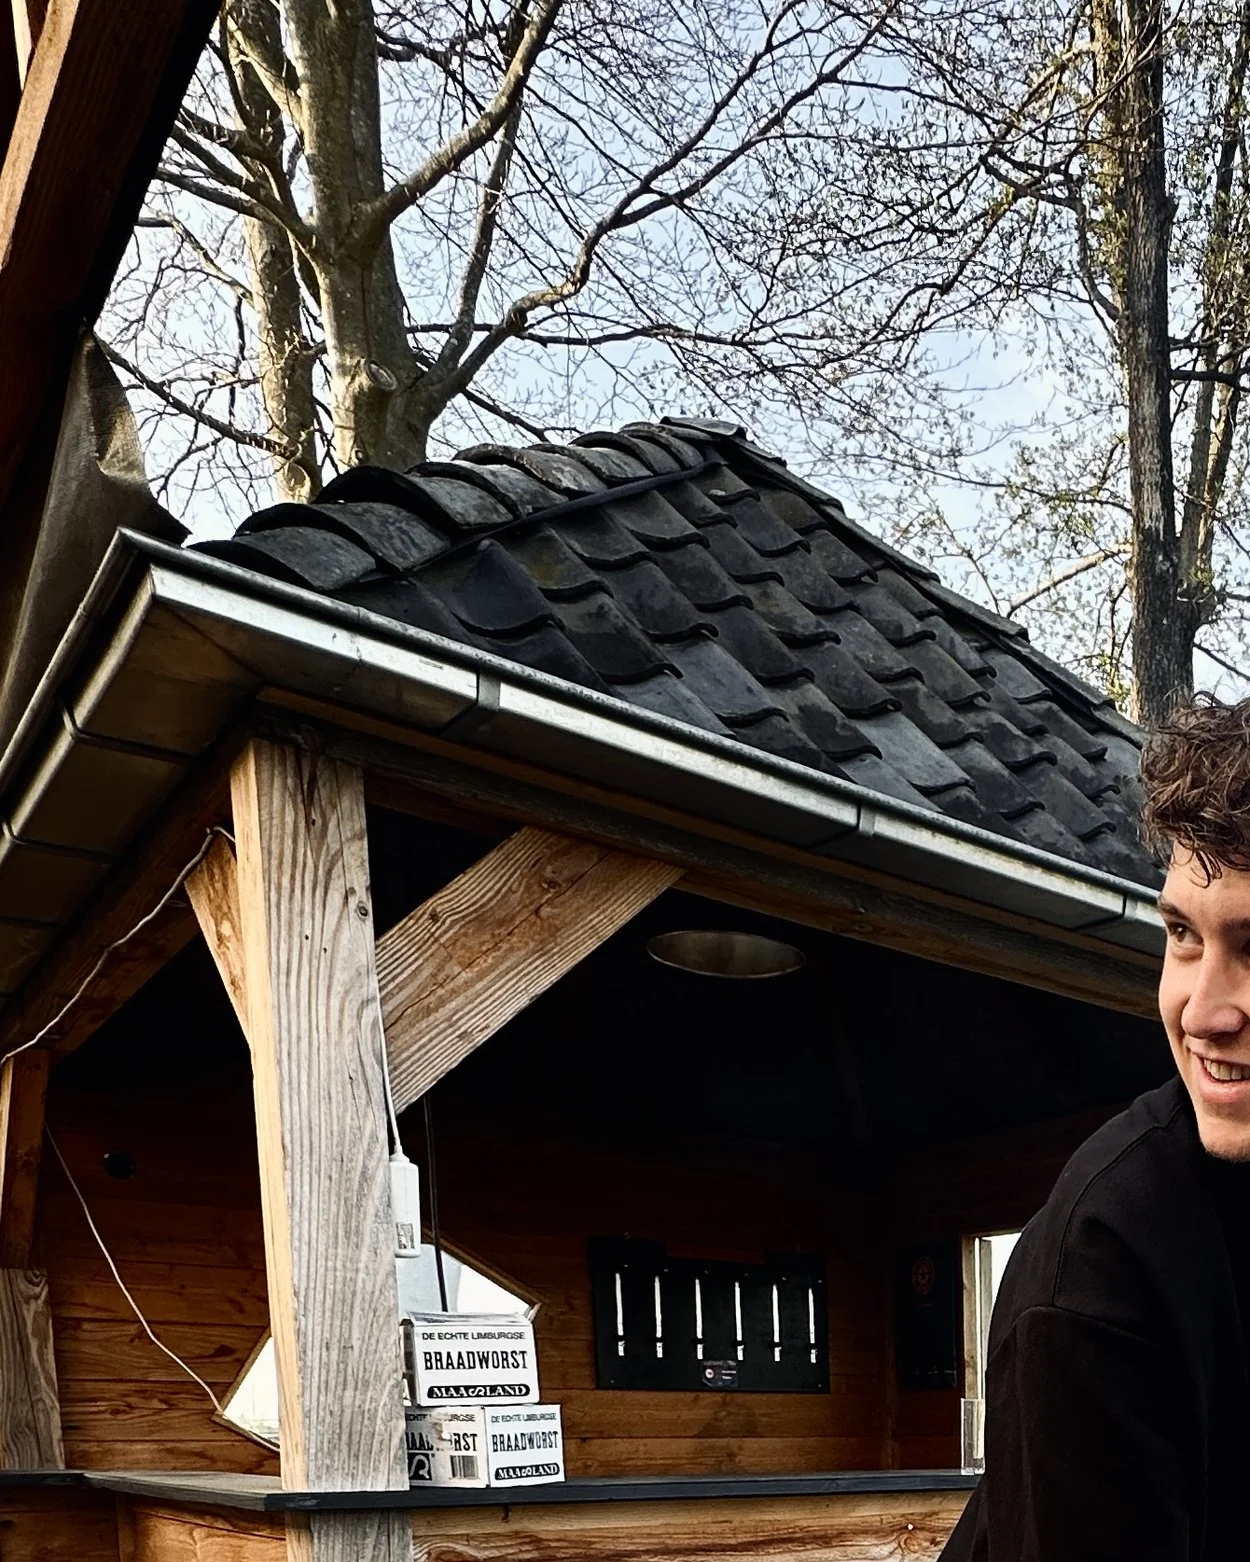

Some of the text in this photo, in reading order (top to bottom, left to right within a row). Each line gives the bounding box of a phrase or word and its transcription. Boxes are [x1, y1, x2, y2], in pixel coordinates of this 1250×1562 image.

[422, 1331, 525, 1340] DE ECHTE LIMBURGSE
[423, 1350, 528, 1370] BRAADWORST
[491, 1430, 558, 1453] BRAADWORST
